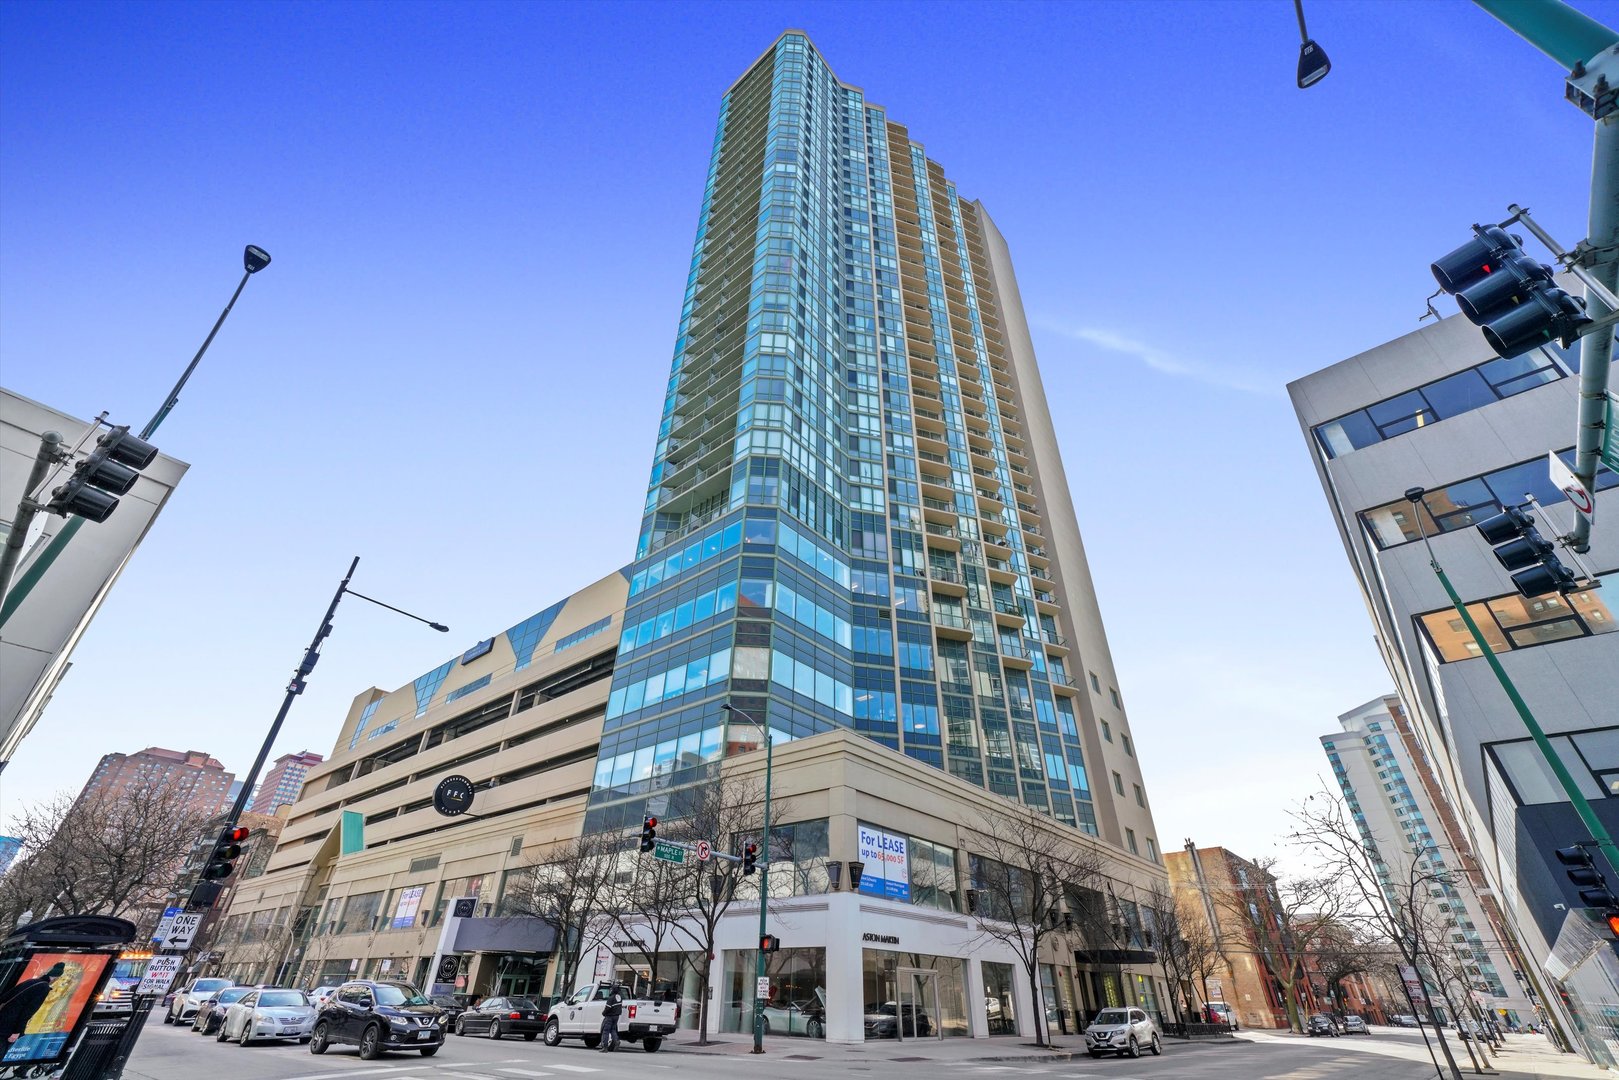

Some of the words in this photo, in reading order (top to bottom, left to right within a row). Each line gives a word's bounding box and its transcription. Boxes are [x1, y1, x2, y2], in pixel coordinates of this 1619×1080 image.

[861, 831, 875, 846] For
[877, 835, 904, 854] LEASE
[660, 846, 678, 856] MAPLE
[861, 849, 870, 859] up
[870, 850, 878, 859] to
[176, 916, 197, 925] ONE
[171, 926, 194, 934] WAY
[862, 932, 880, 942] ASTON
